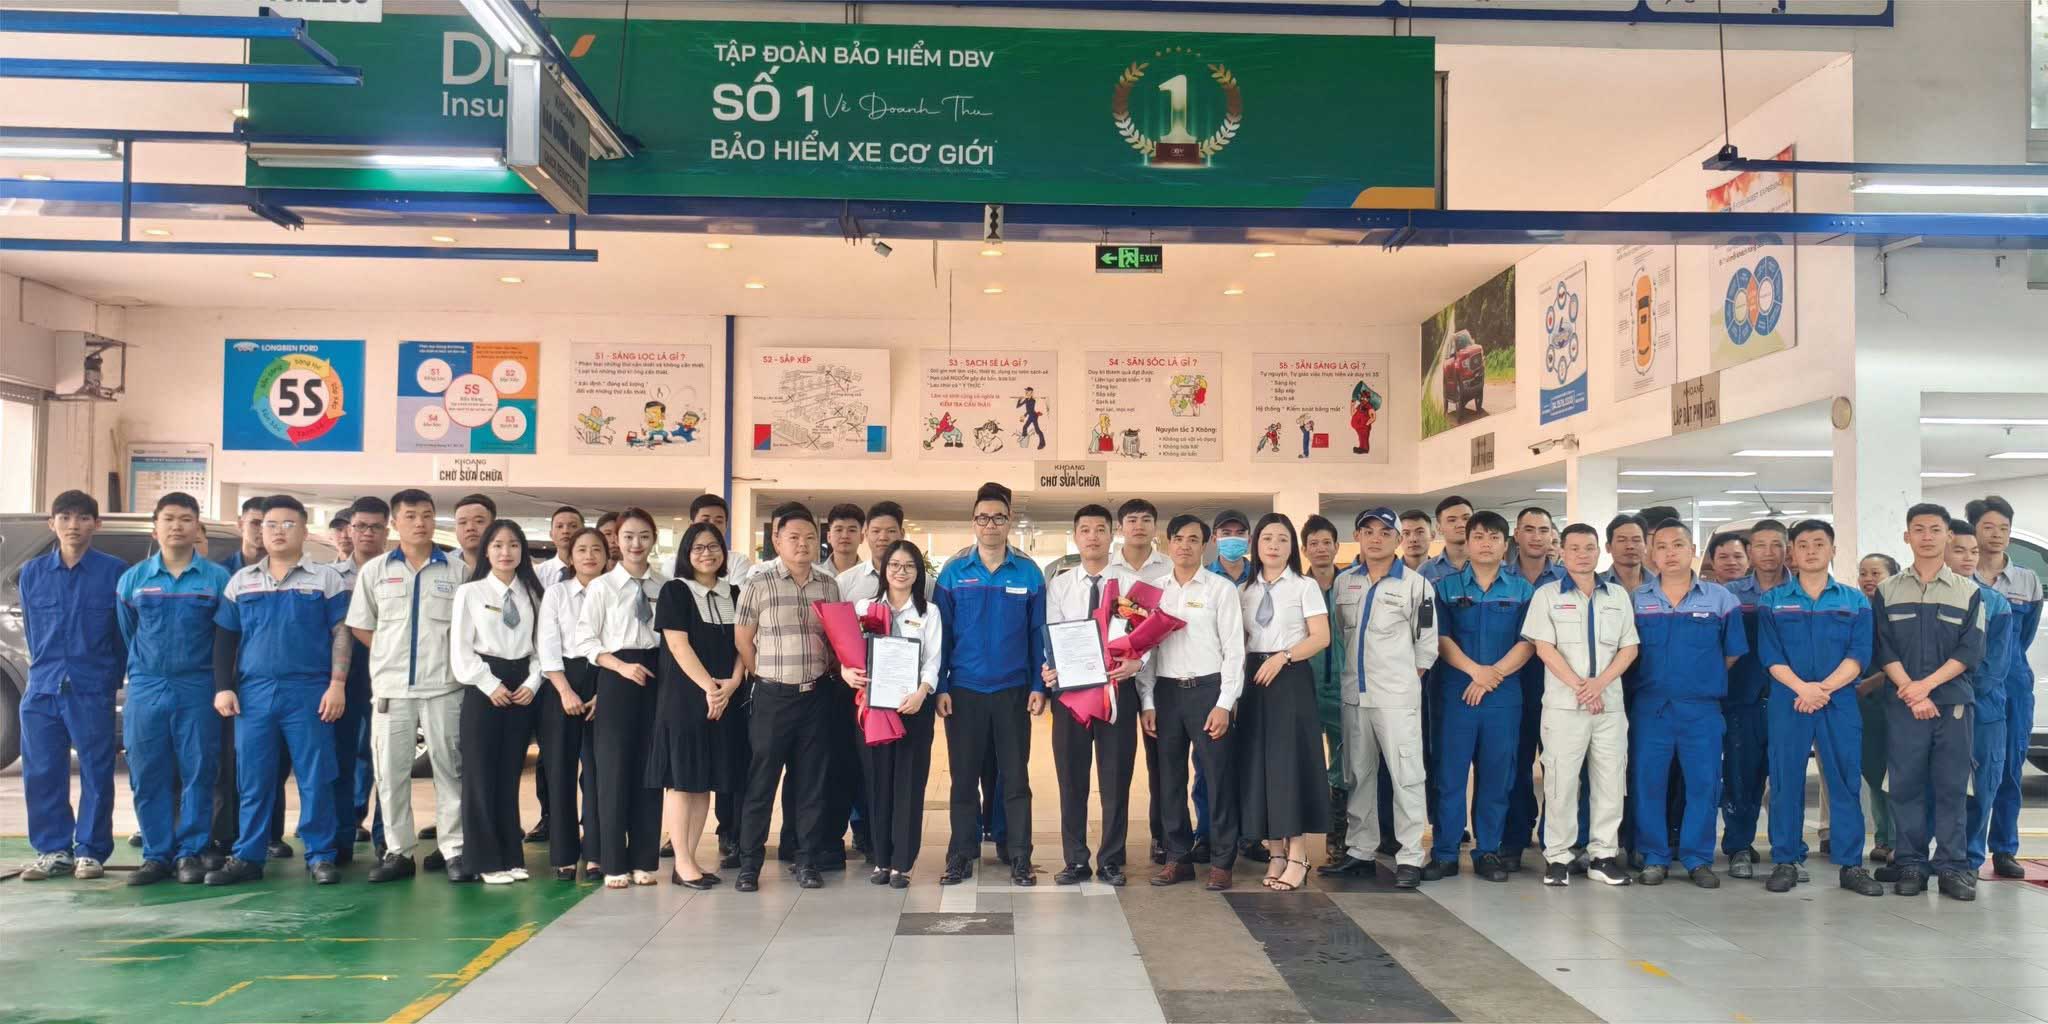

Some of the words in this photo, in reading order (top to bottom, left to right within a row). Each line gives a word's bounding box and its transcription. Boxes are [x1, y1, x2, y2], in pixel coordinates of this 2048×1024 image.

[714, 40, 756, 66] TẬP
[762, 40, 826, 64] ĐOÀN
[834, 41, 880, 64] BẢO
[887, 40, 941, 66] HIỂM
[949, 49, 994, 68] DBV
[712, 66, 780, 122] SỐ
[796, 85, 814, 122] 1
[859, 92, 940, 120] Doanh
[942, 95, 992, 122] Thu
[711, 131, 765, 160] BẢO
[774, 130, 839, 160] HIỂM
[848, 142, 881, 162] XE
[890, 143, 932, 163] CƠ
[938, 139, 994, 165] GIỚI
[1146, 357, 1165, 366] SÓC
[1168, 358, 1178, 366] LÀ
[1180, 358, 1190, 366] GÌ
[1314, 360, 1336, 370] SÀNG
[1339, 360, 1348, 370] LÀ
[1350, 360, 1360, 370] GÌ
[279, 378, 323, 416] 5S
[464, 384, 480, 395] 5S
